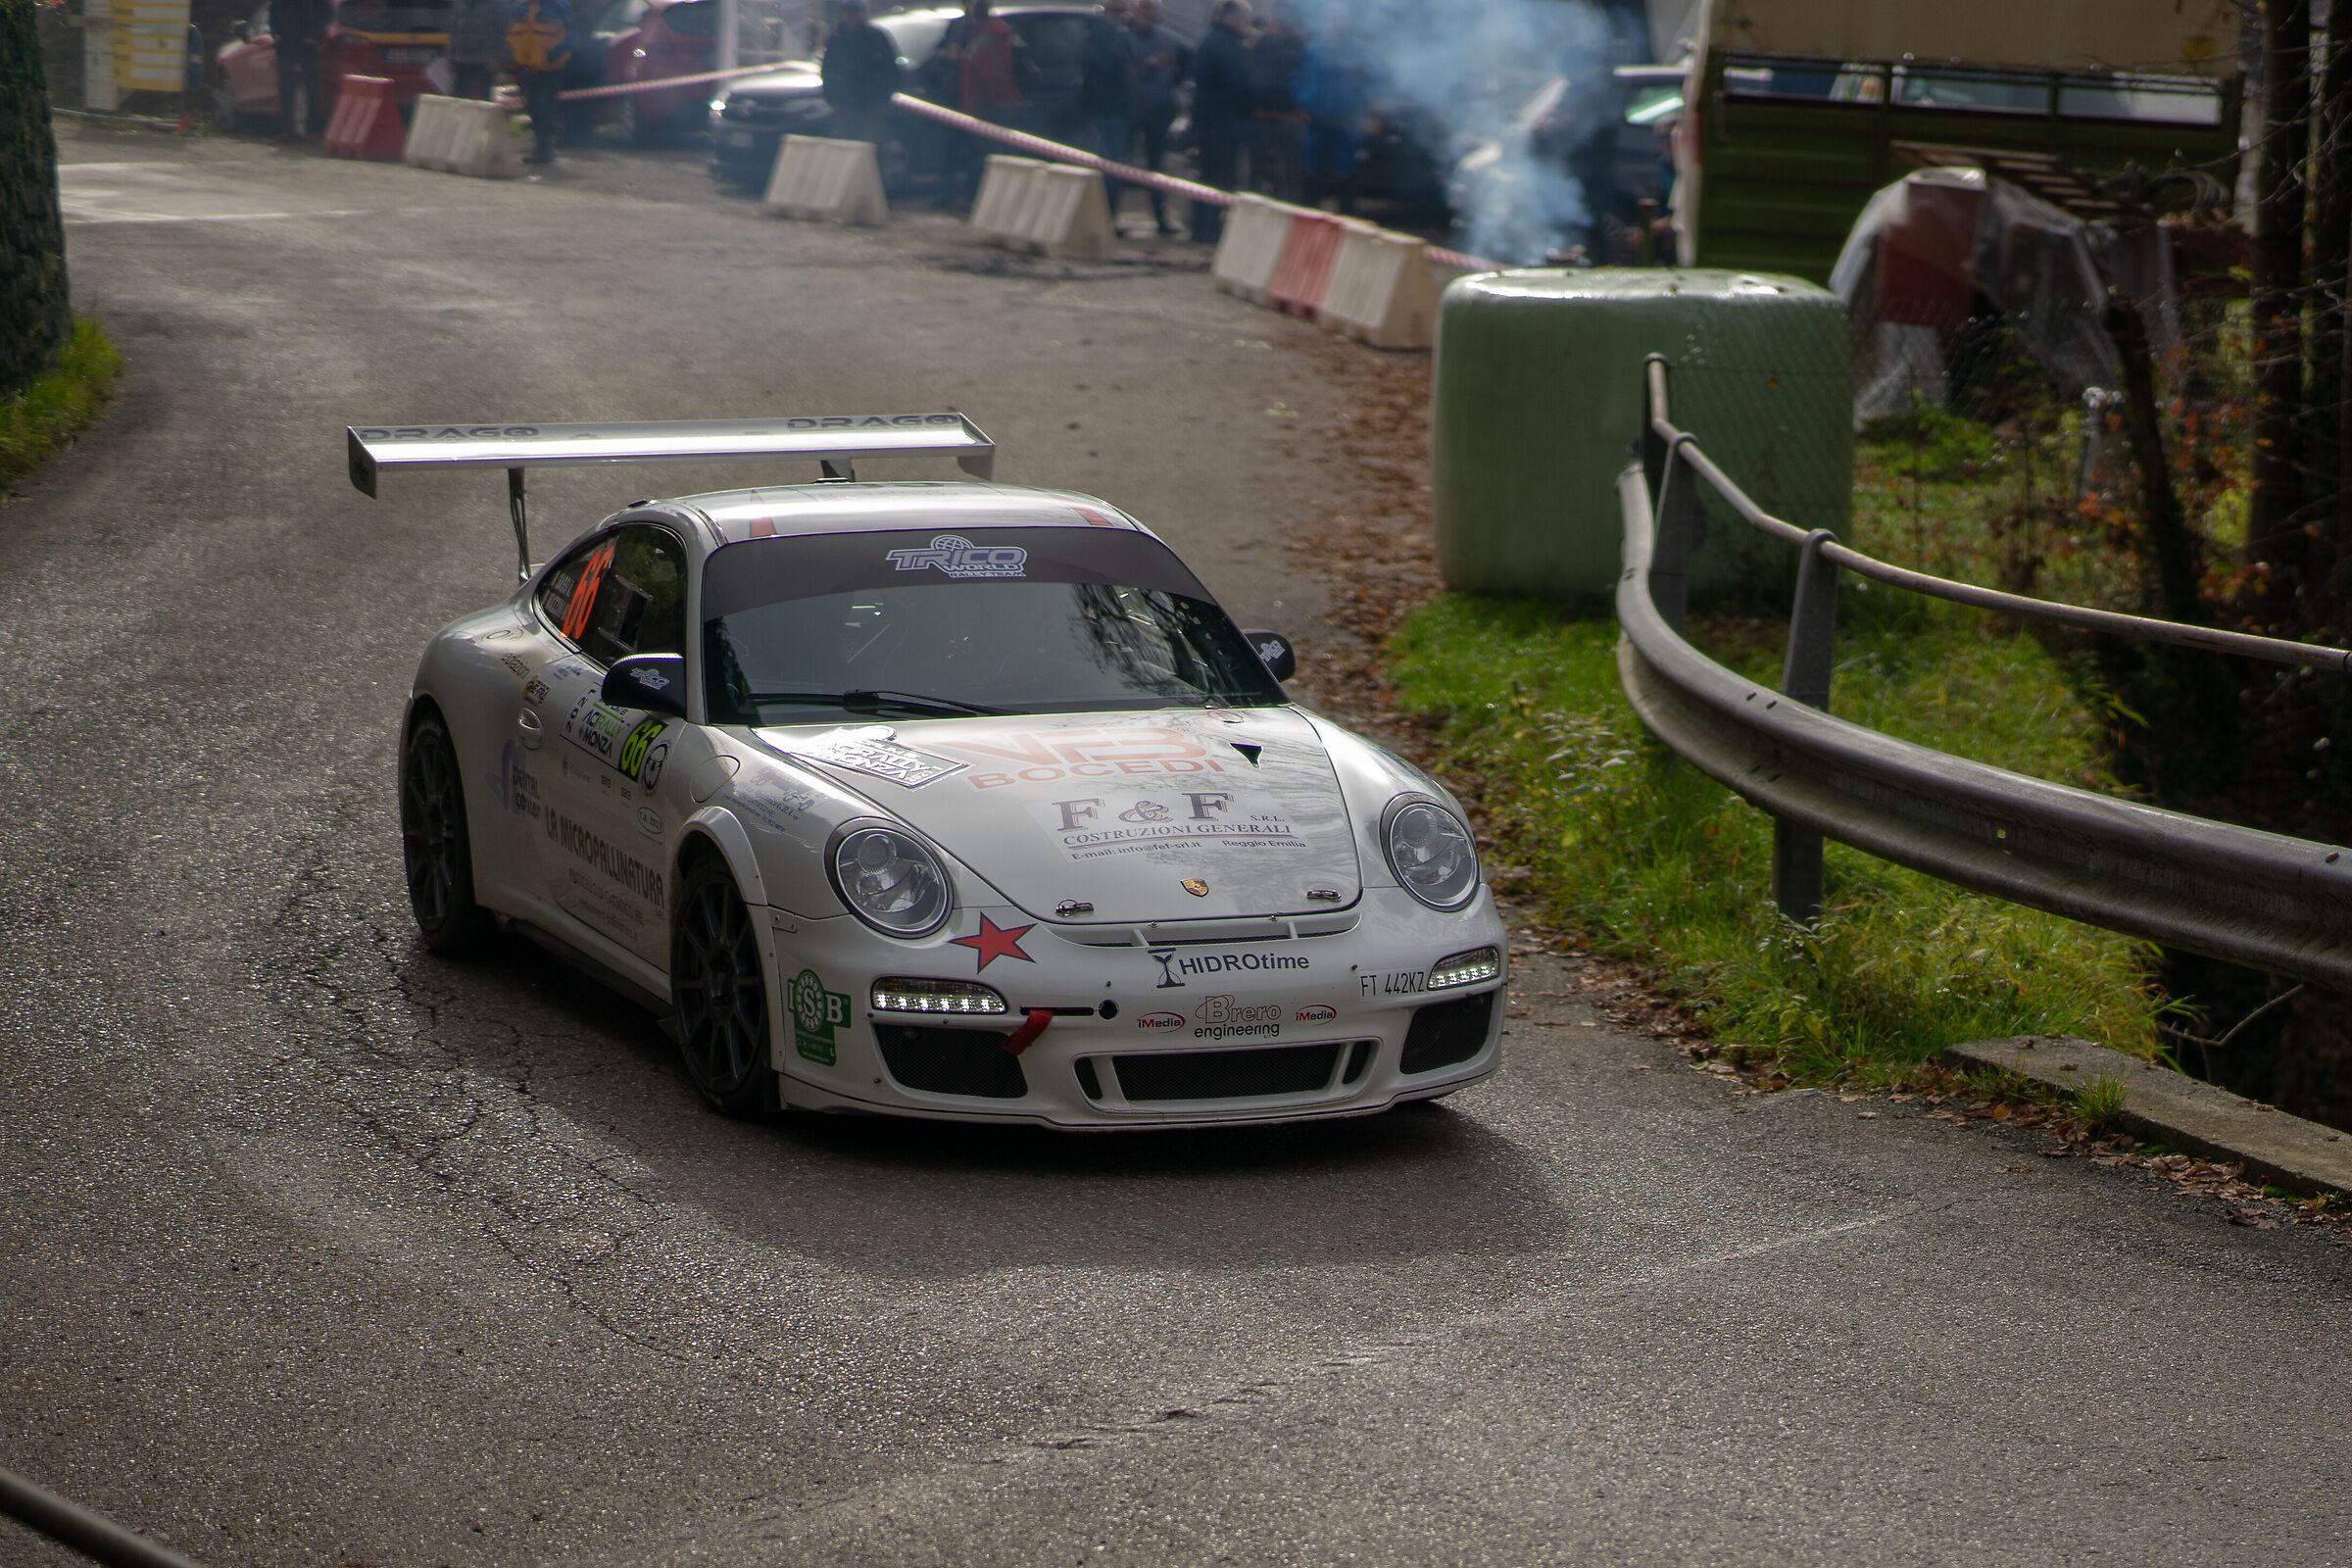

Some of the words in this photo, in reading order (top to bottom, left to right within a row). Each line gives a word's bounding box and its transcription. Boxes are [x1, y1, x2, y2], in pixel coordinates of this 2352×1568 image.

[888, 547, 1025, 569] TRICO
[562, 545, 613, 640] 66
[583, 727, 612, 759] MONZA
[621, 719, 662, 777] 66
[966, 759, 1225, 790] BOCEDI
[1052, 797, 1105, 832] F
[1117, 800, 1173, 823] &
[1181, 792, 1235, 821] F
[1063, 824, 1191, 846] COSTRUZIONI
[1198, 824, 1292, 834] GENERALI
[545, 805, 558, 843] LA
[560, 814, 665, 909] MICROPALLINATURA
[1072, 848, 1116, 860] E-mail:
[1223, 839, 1265, 849] Reggio
[1268, 839, 1306, 849] Emilia
[1179, 954, 1309, 975] HIDROtime
[1360, 974, 1377, 997] FT
[1385, 971, 1425, 994] 442KZ
[1138, 1017, 1182, 1029] iMedia
[1205, 996, 1282, 1024] Brero
[1296, 1010, 1333, 1022] iMedia
[1194, 1022, 1280, 1040] engineering
